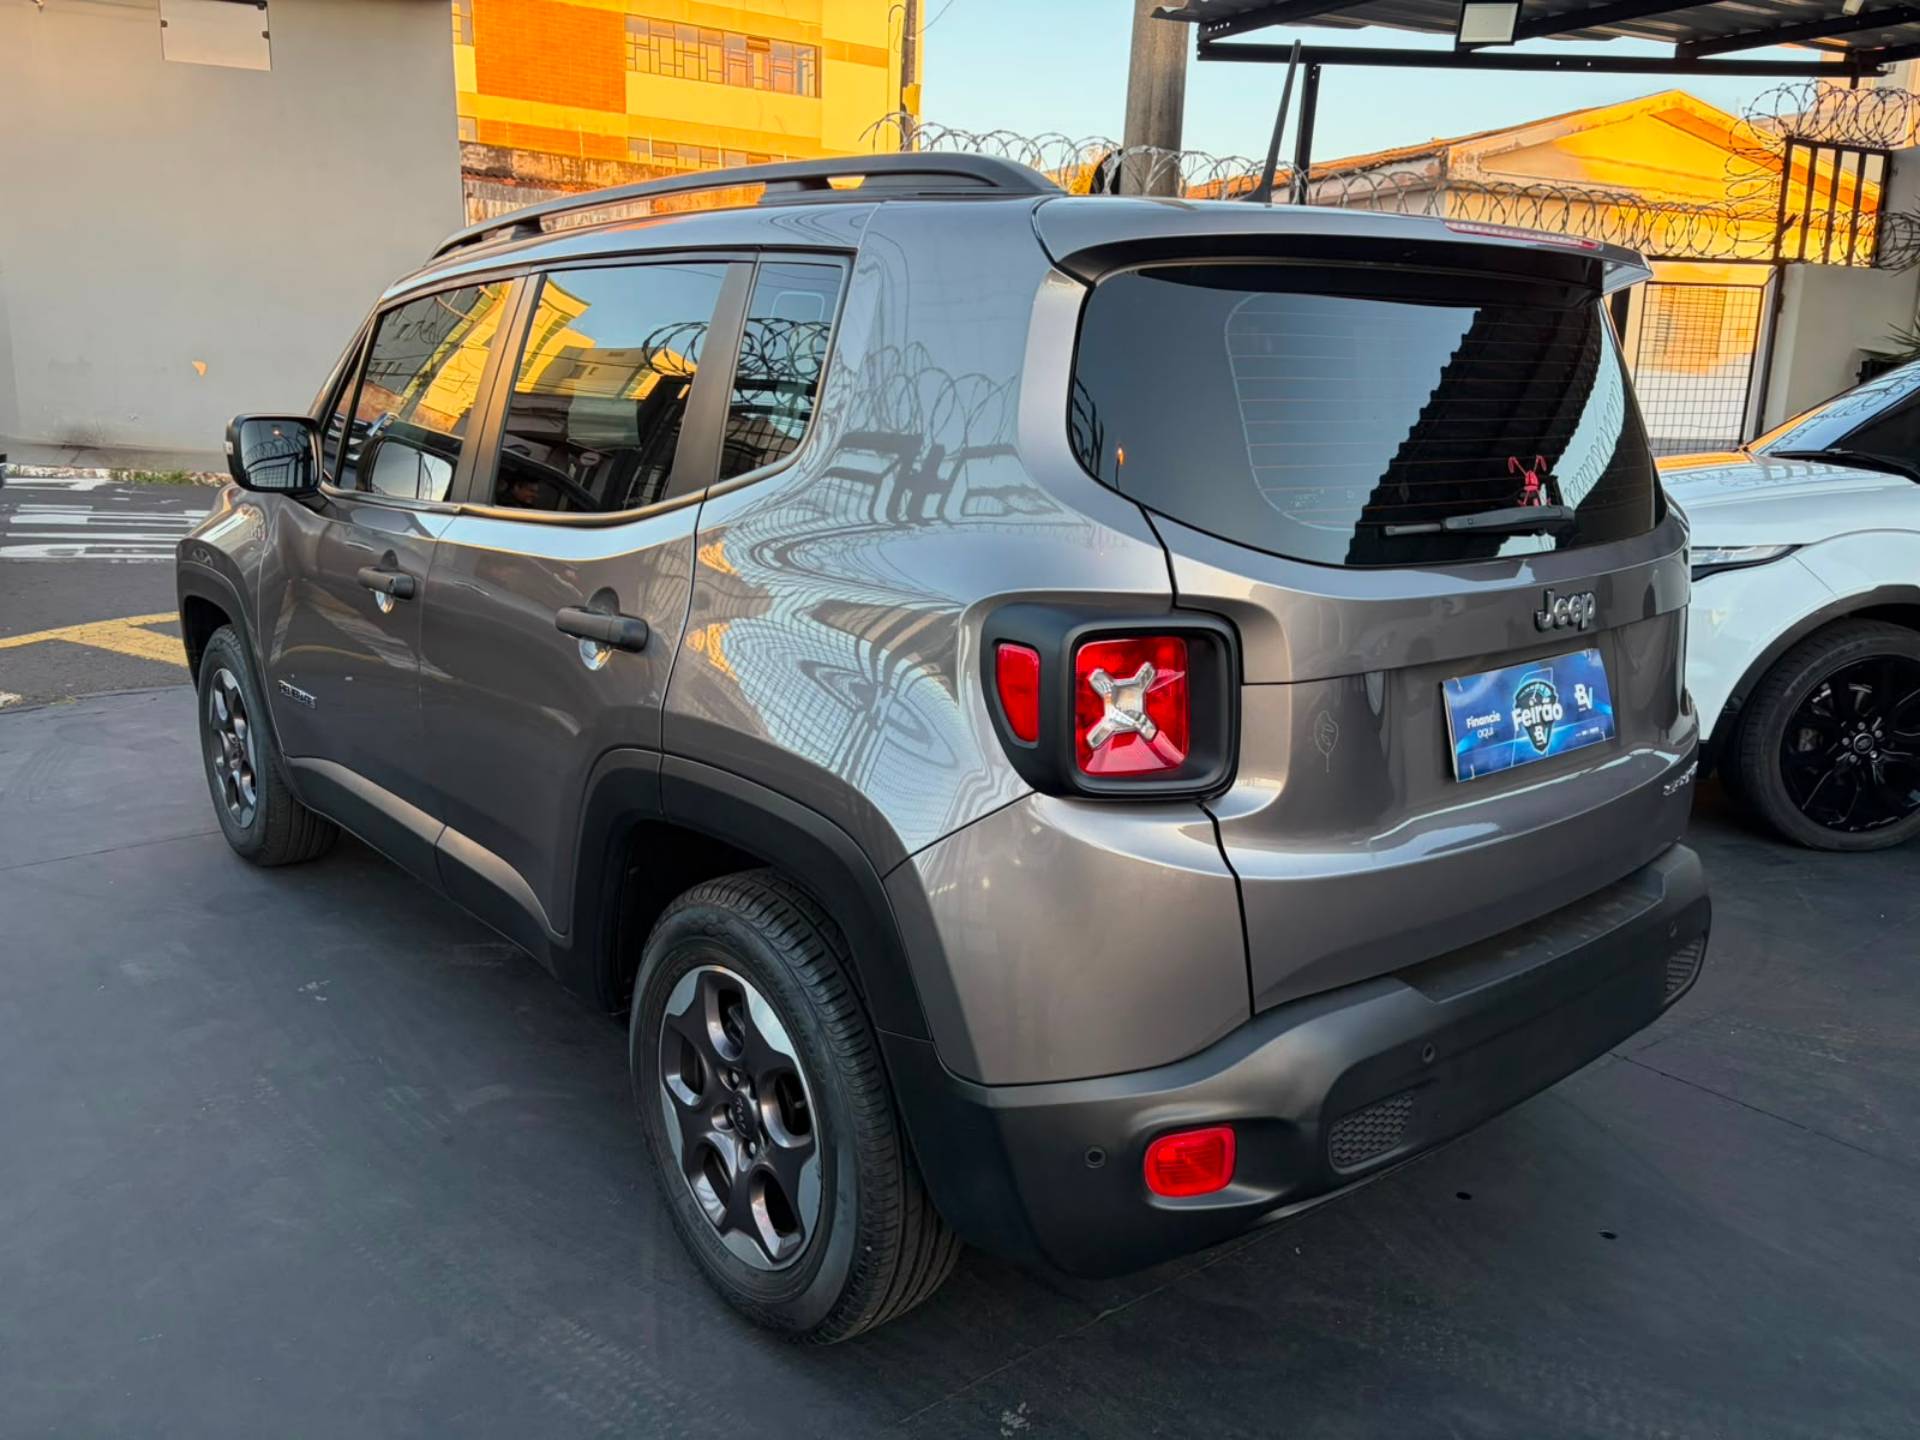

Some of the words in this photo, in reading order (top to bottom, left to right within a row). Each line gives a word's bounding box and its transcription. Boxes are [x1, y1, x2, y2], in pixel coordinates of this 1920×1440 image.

[1536, 590, 1596, 630] Jeep
[1466, 710, 1501, 728] Financie
[1512, 697, 1563, 731] Feirão
[1477, 727, 1494, 739] aqui
